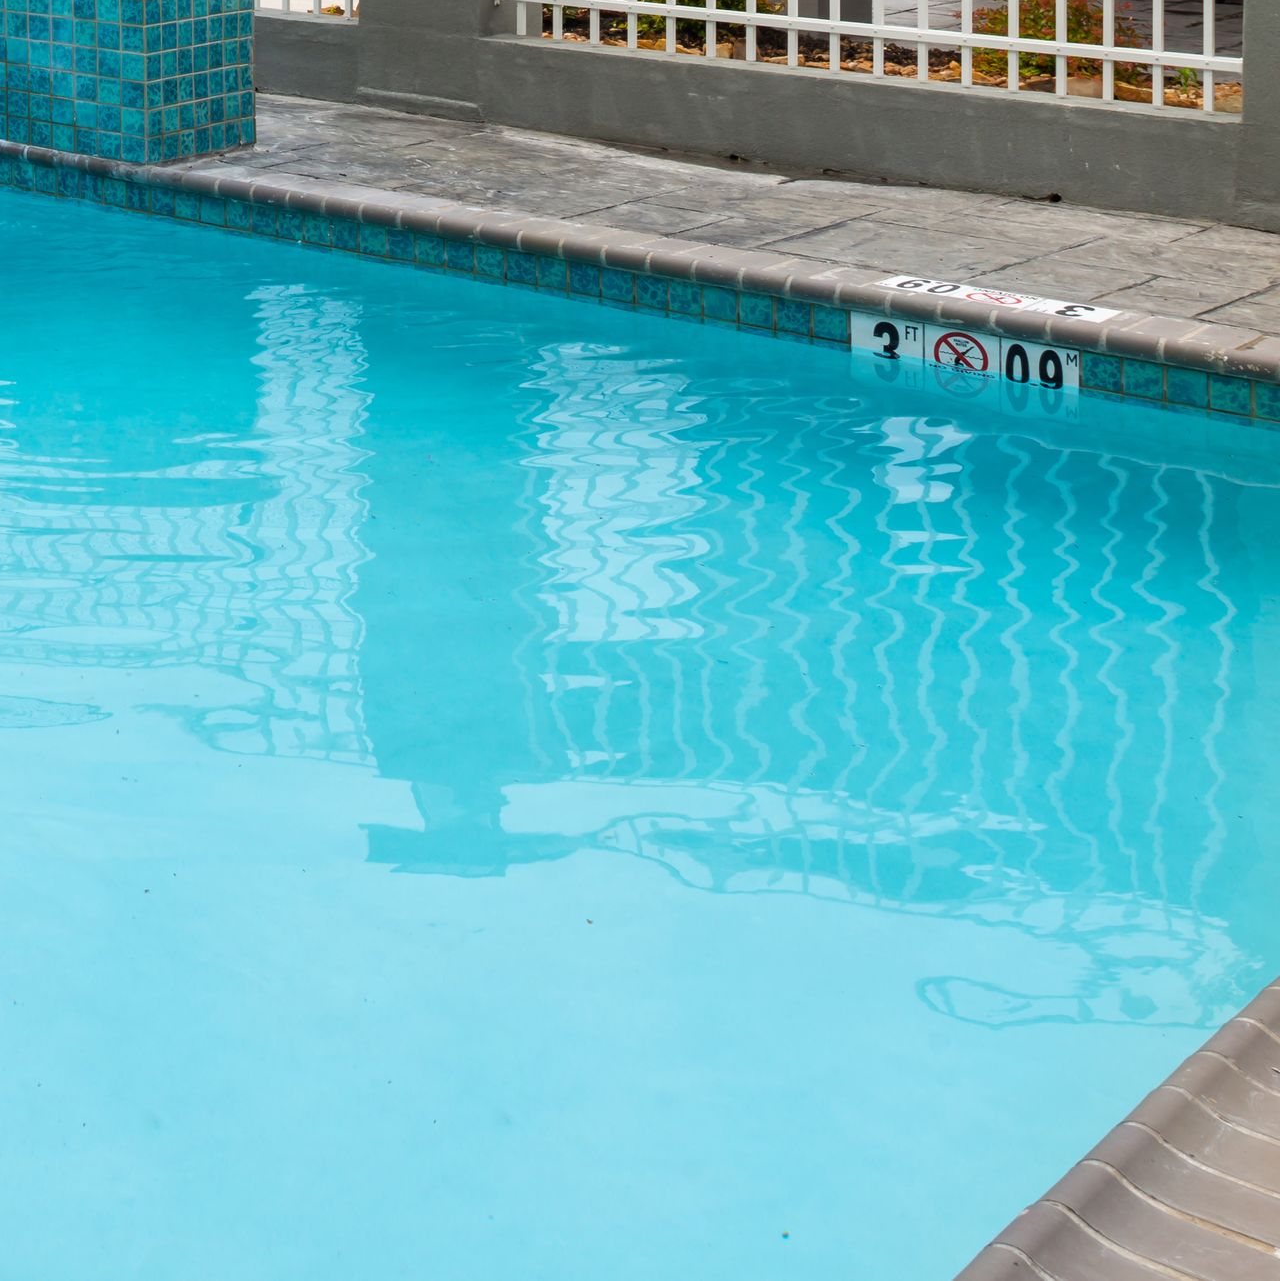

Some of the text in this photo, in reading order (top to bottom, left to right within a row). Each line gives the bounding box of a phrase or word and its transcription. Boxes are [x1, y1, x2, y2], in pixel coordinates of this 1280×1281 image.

[873, 321, 900, 359] 3
[905, 325, 919, 342] FT
[1066, 353, 1078, 368] M
